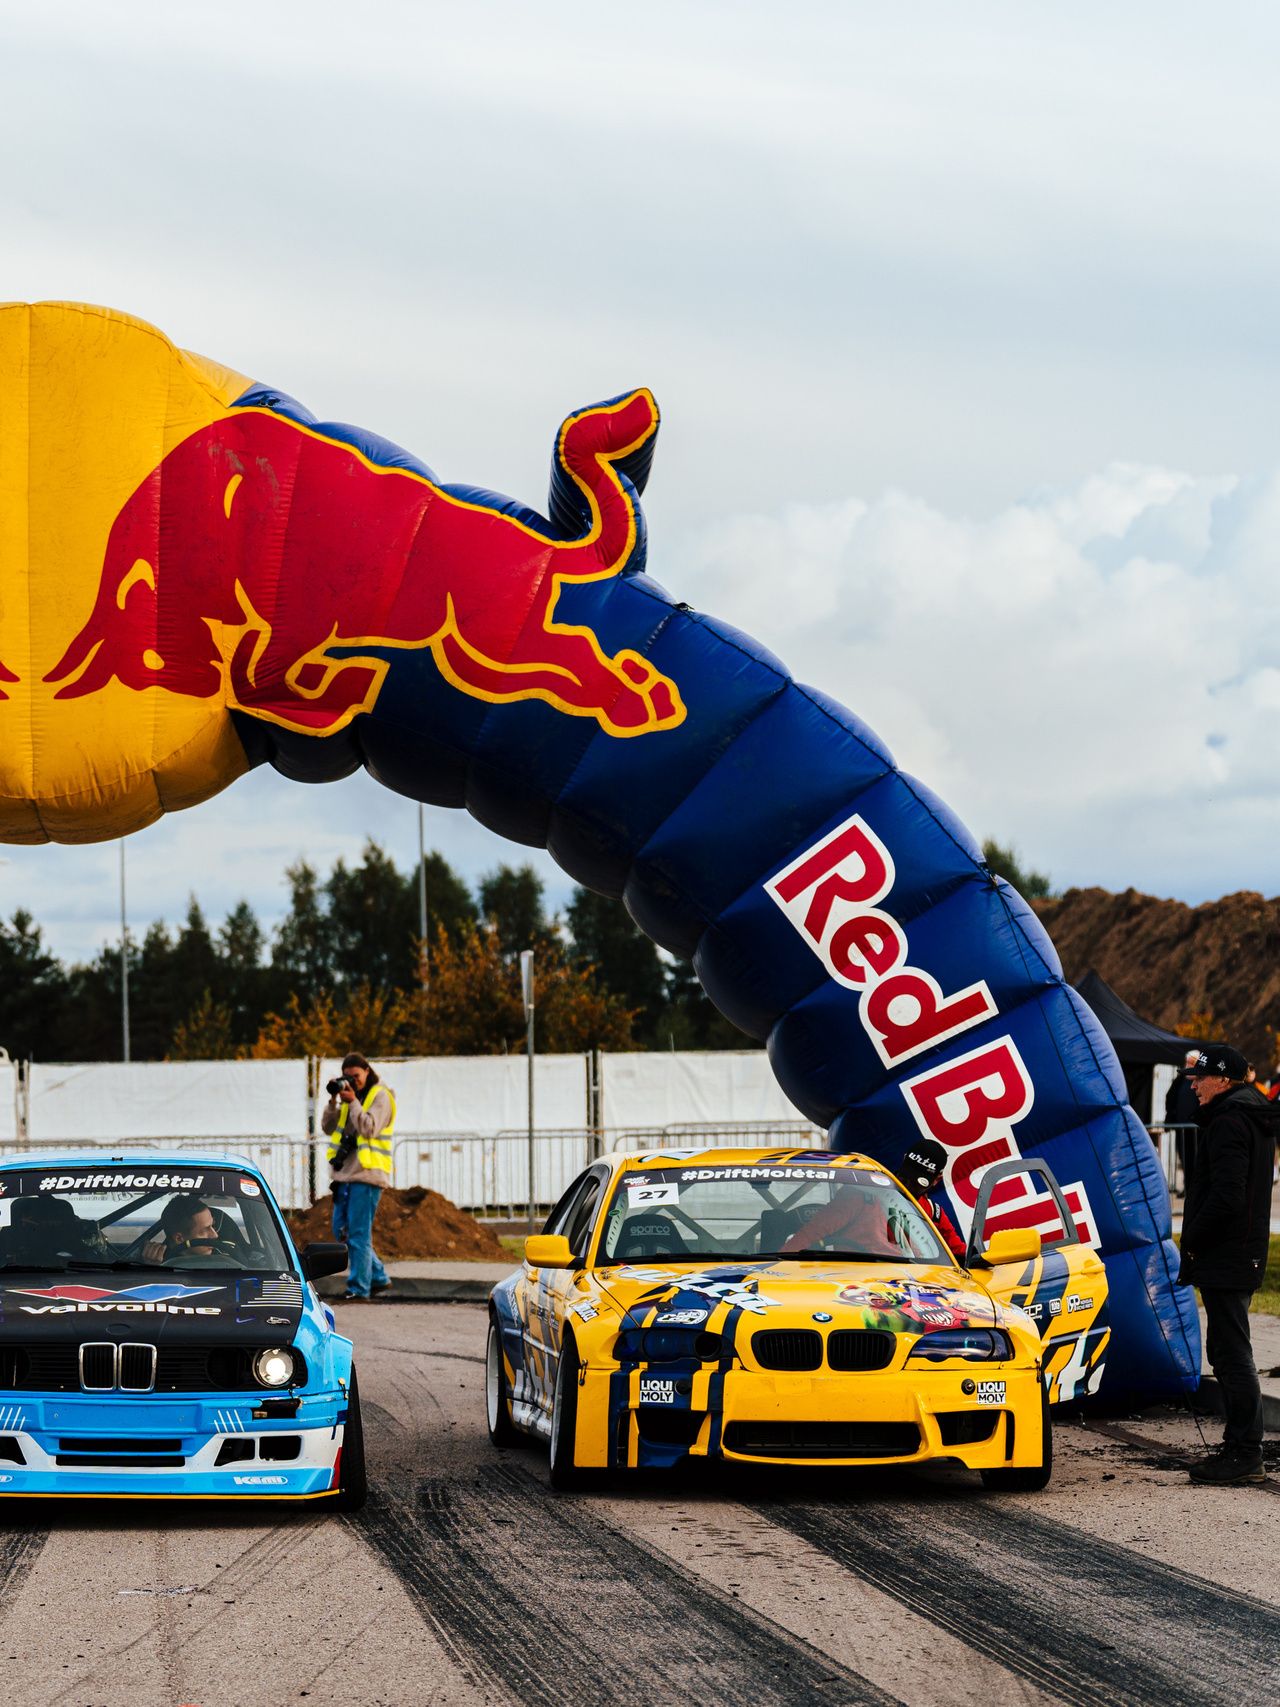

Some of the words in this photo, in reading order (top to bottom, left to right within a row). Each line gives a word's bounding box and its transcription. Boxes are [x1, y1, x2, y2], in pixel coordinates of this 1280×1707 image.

[769, 819, 994, 1063] Red
[638, 1190, 669, 1200] 27
[641, 1380, 673, 1391] LIQUI
[978, 1382, 1006, 1393] LIQUI
[641, 1392, 672, 1402] MOLY
[978, 1393, 1005, 1403] MOLY
